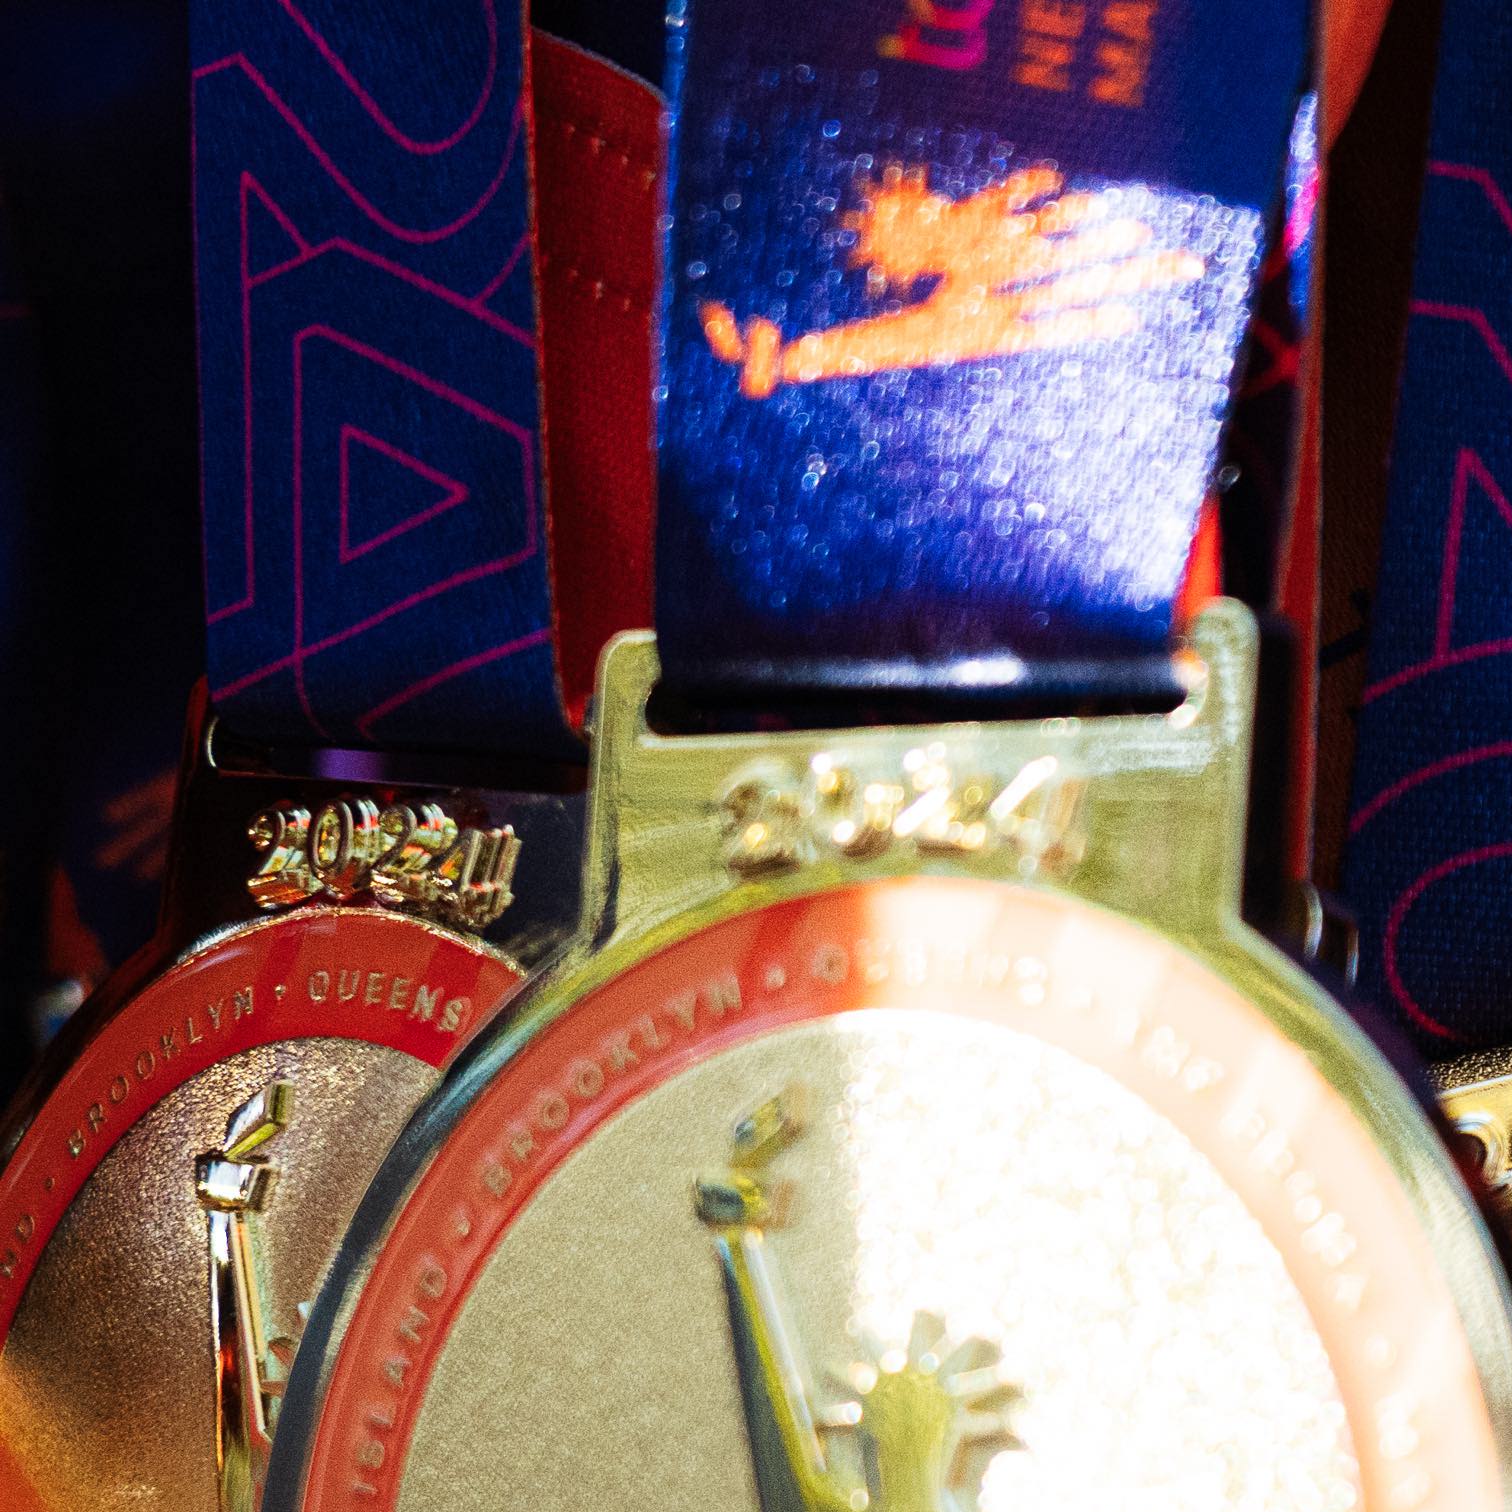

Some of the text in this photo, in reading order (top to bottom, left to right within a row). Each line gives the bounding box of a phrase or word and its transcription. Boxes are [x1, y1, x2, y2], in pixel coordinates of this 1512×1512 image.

[246, 800, 522, 930] 2024
[65, 984, 256, 1160] BROOKLYN
[306, 970, 471, 1034] QUEENS
